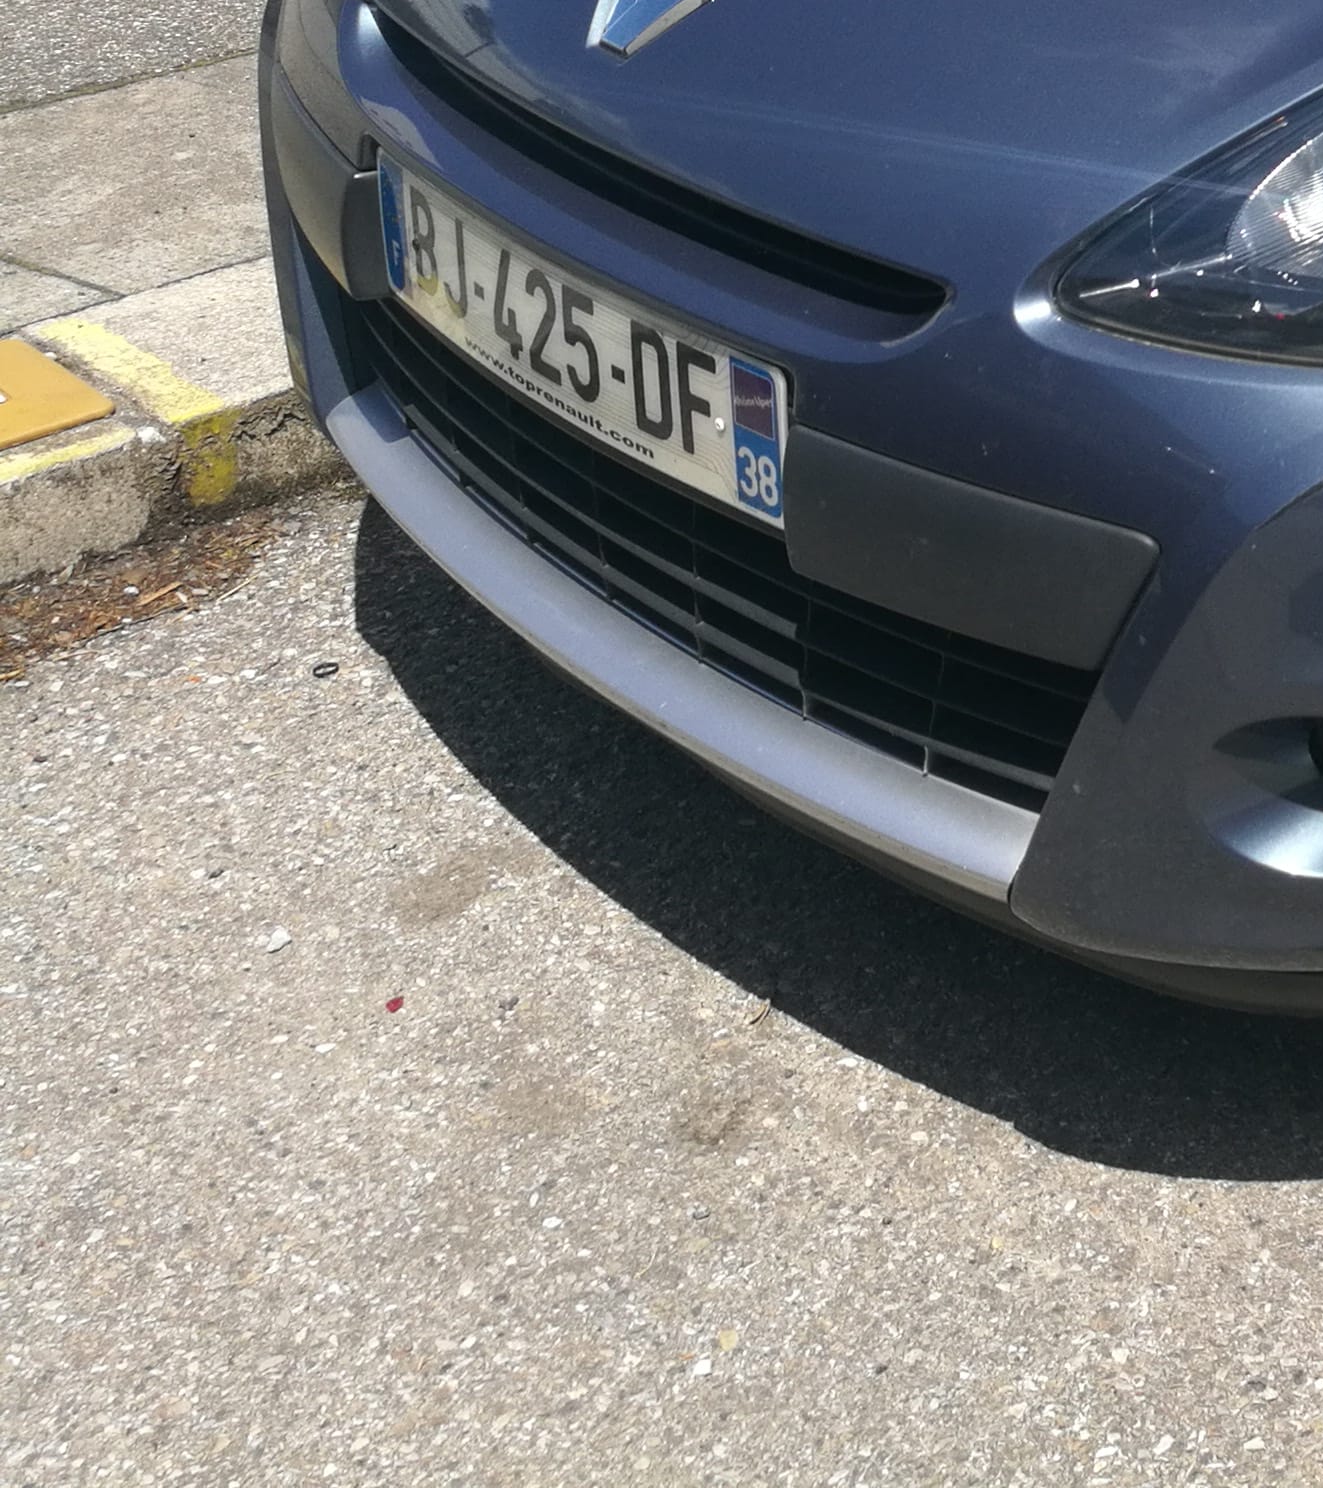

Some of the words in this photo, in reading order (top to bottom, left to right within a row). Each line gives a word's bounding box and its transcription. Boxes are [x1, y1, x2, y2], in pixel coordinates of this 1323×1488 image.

[391, 239, 401, 266] F
[409, 185, 716, 455] BJ-425-DF
[464, 336, 655, 460] www.toprenault.com
[737, 446, 779, 507] 38
